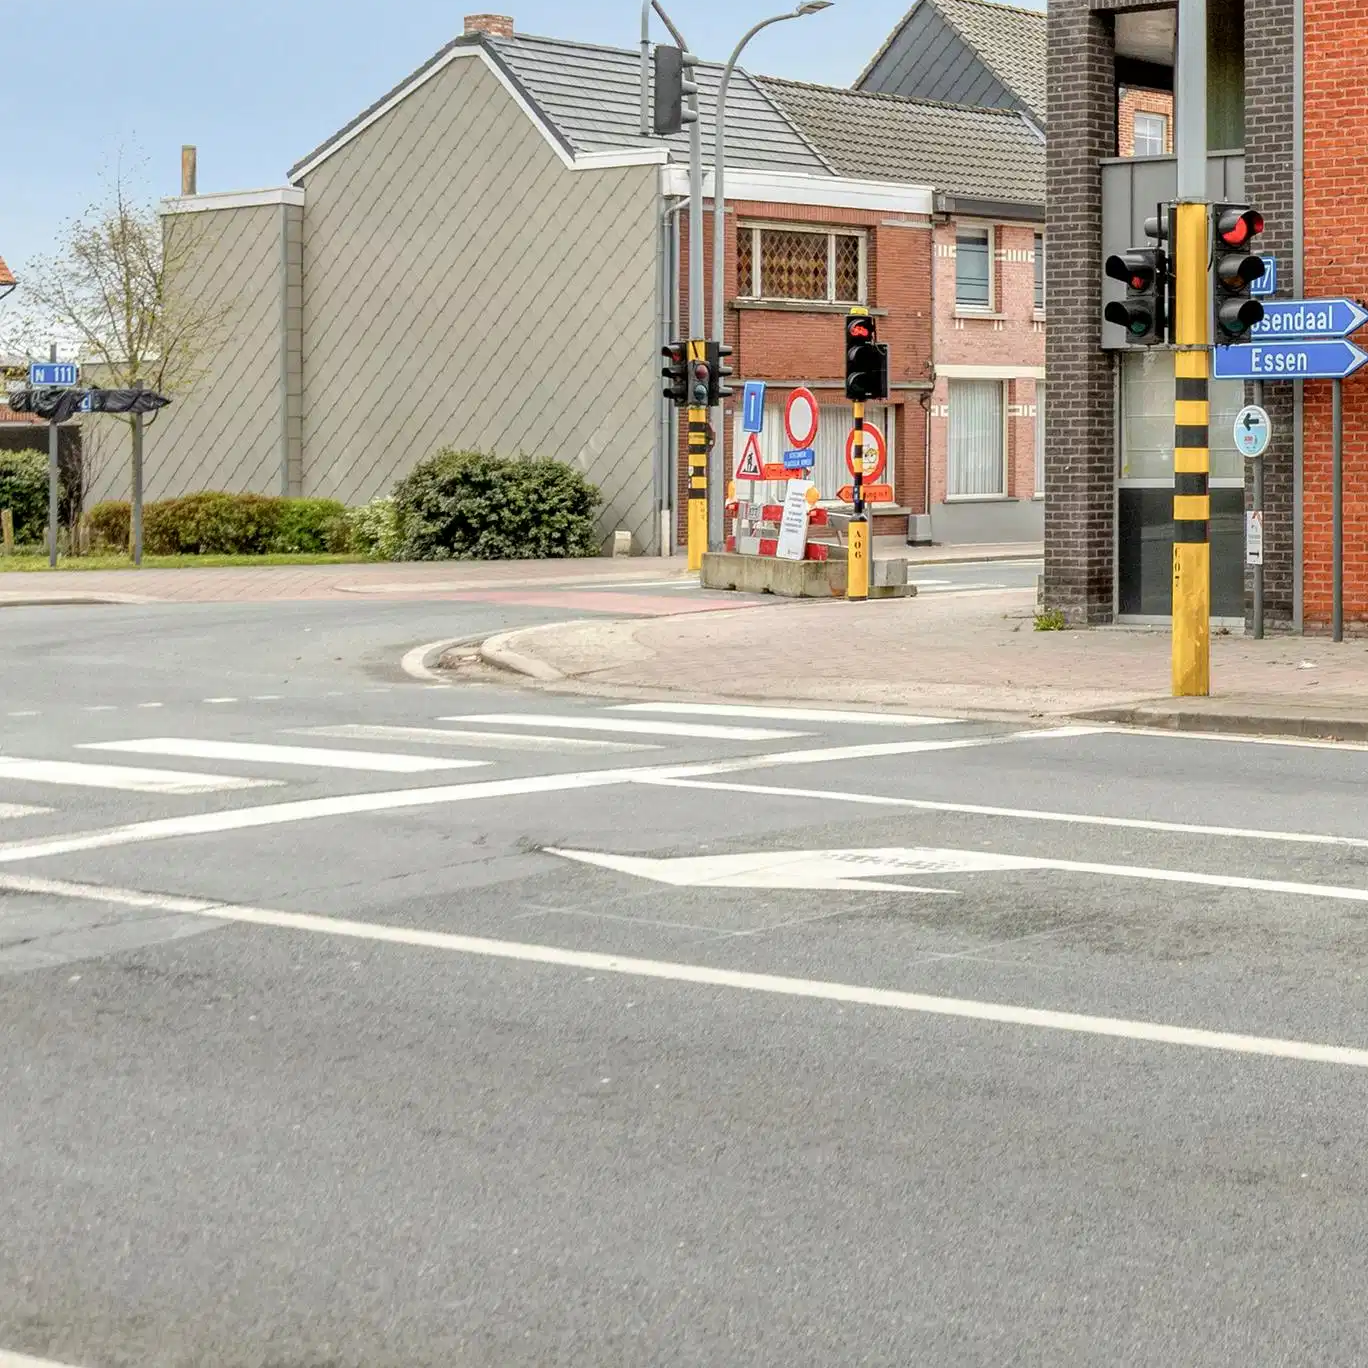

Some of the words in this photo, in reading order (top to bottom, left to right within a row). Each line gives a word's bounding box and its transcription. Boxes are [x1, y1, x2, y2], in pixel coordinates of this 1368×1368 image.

[1251, 305, 1333, 332] osendaal
[1251, 348, 1307, 372] Essen
[35, 368, 45, 382] N
[54, 367, 72, 382] 111
